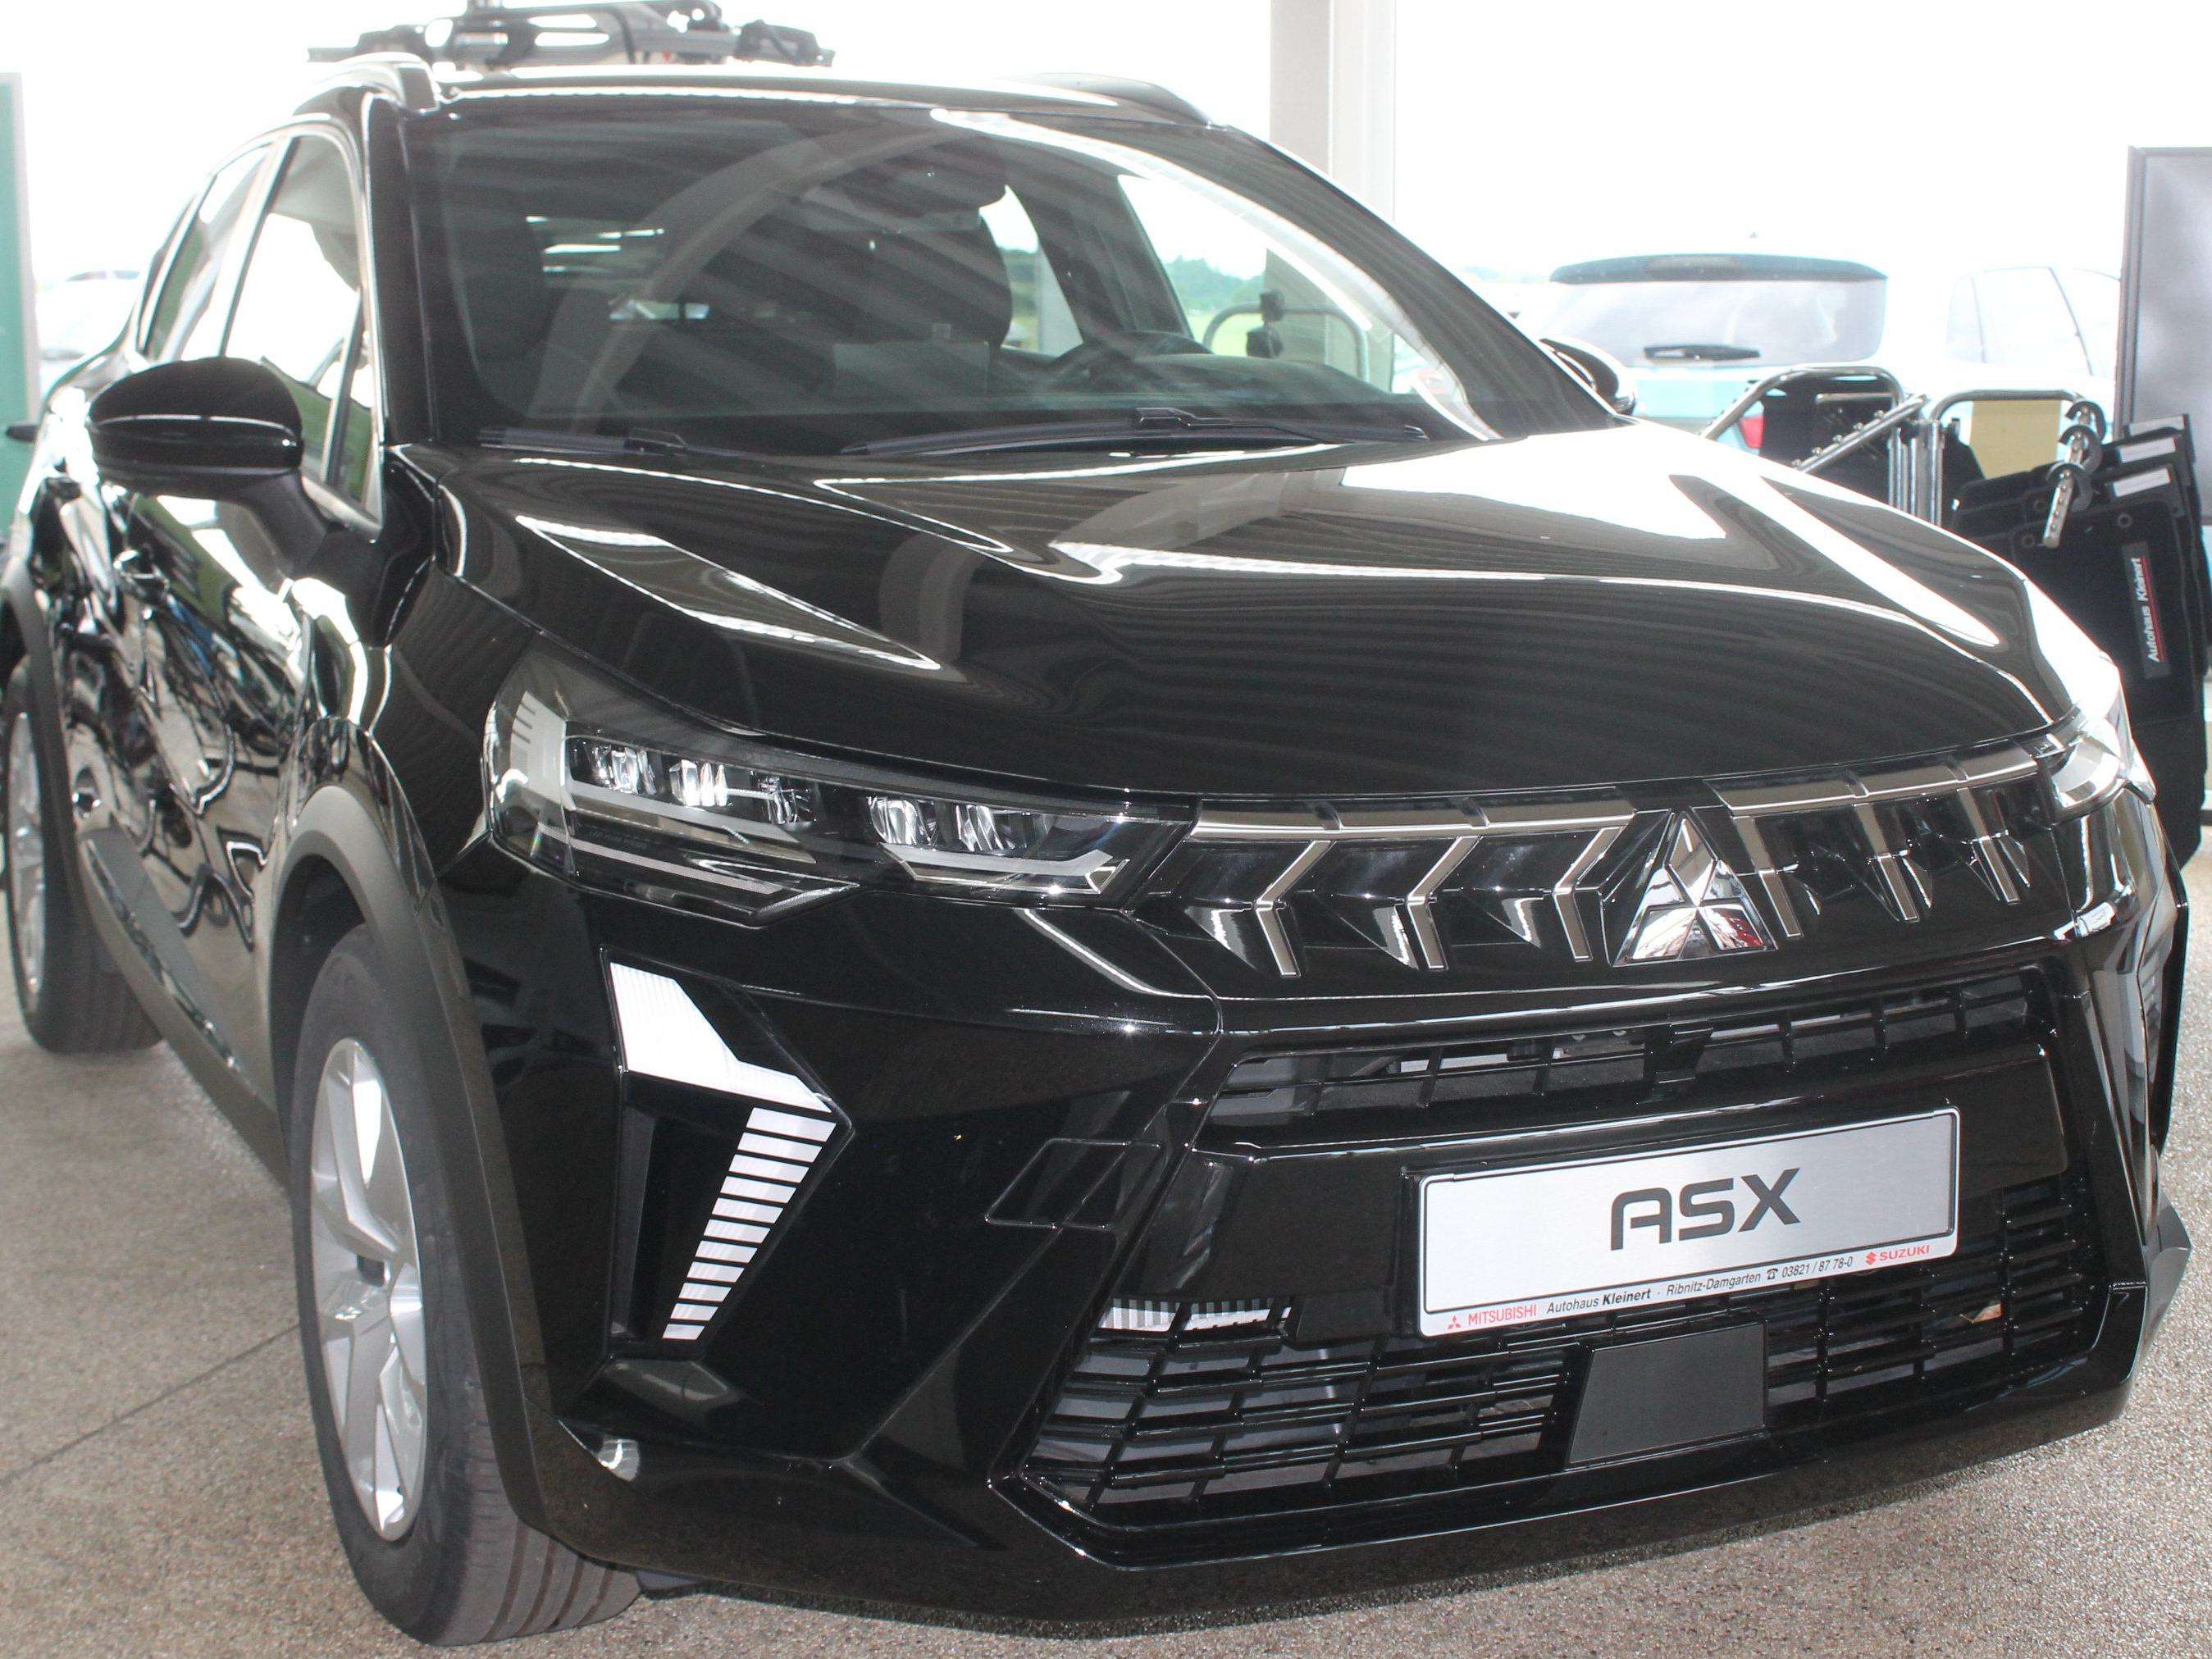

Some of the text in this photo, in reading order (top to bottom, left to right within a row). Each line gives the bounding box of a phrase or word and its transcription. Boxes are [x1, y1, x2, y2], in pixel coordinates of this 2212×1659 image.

[2141, 605, 2160, 663] Autohaus
[1610, 1167, 1801, 1251] ASX
[1879, 1244, 1930, 1262] SUZUKI
[1546, 1297, 1599, 1315] Autohaus
[1602, 1288, 1652, 1306] Kleinert
[1666, 1273, 1761, 1297] Ribnitz-Damgarten
[1781, 1262, 1809, 1278] 03821
[1832, 1256, 1854, 1270] 78-0
[1467, 1304, 1537, 1326] MITSUBISHI
